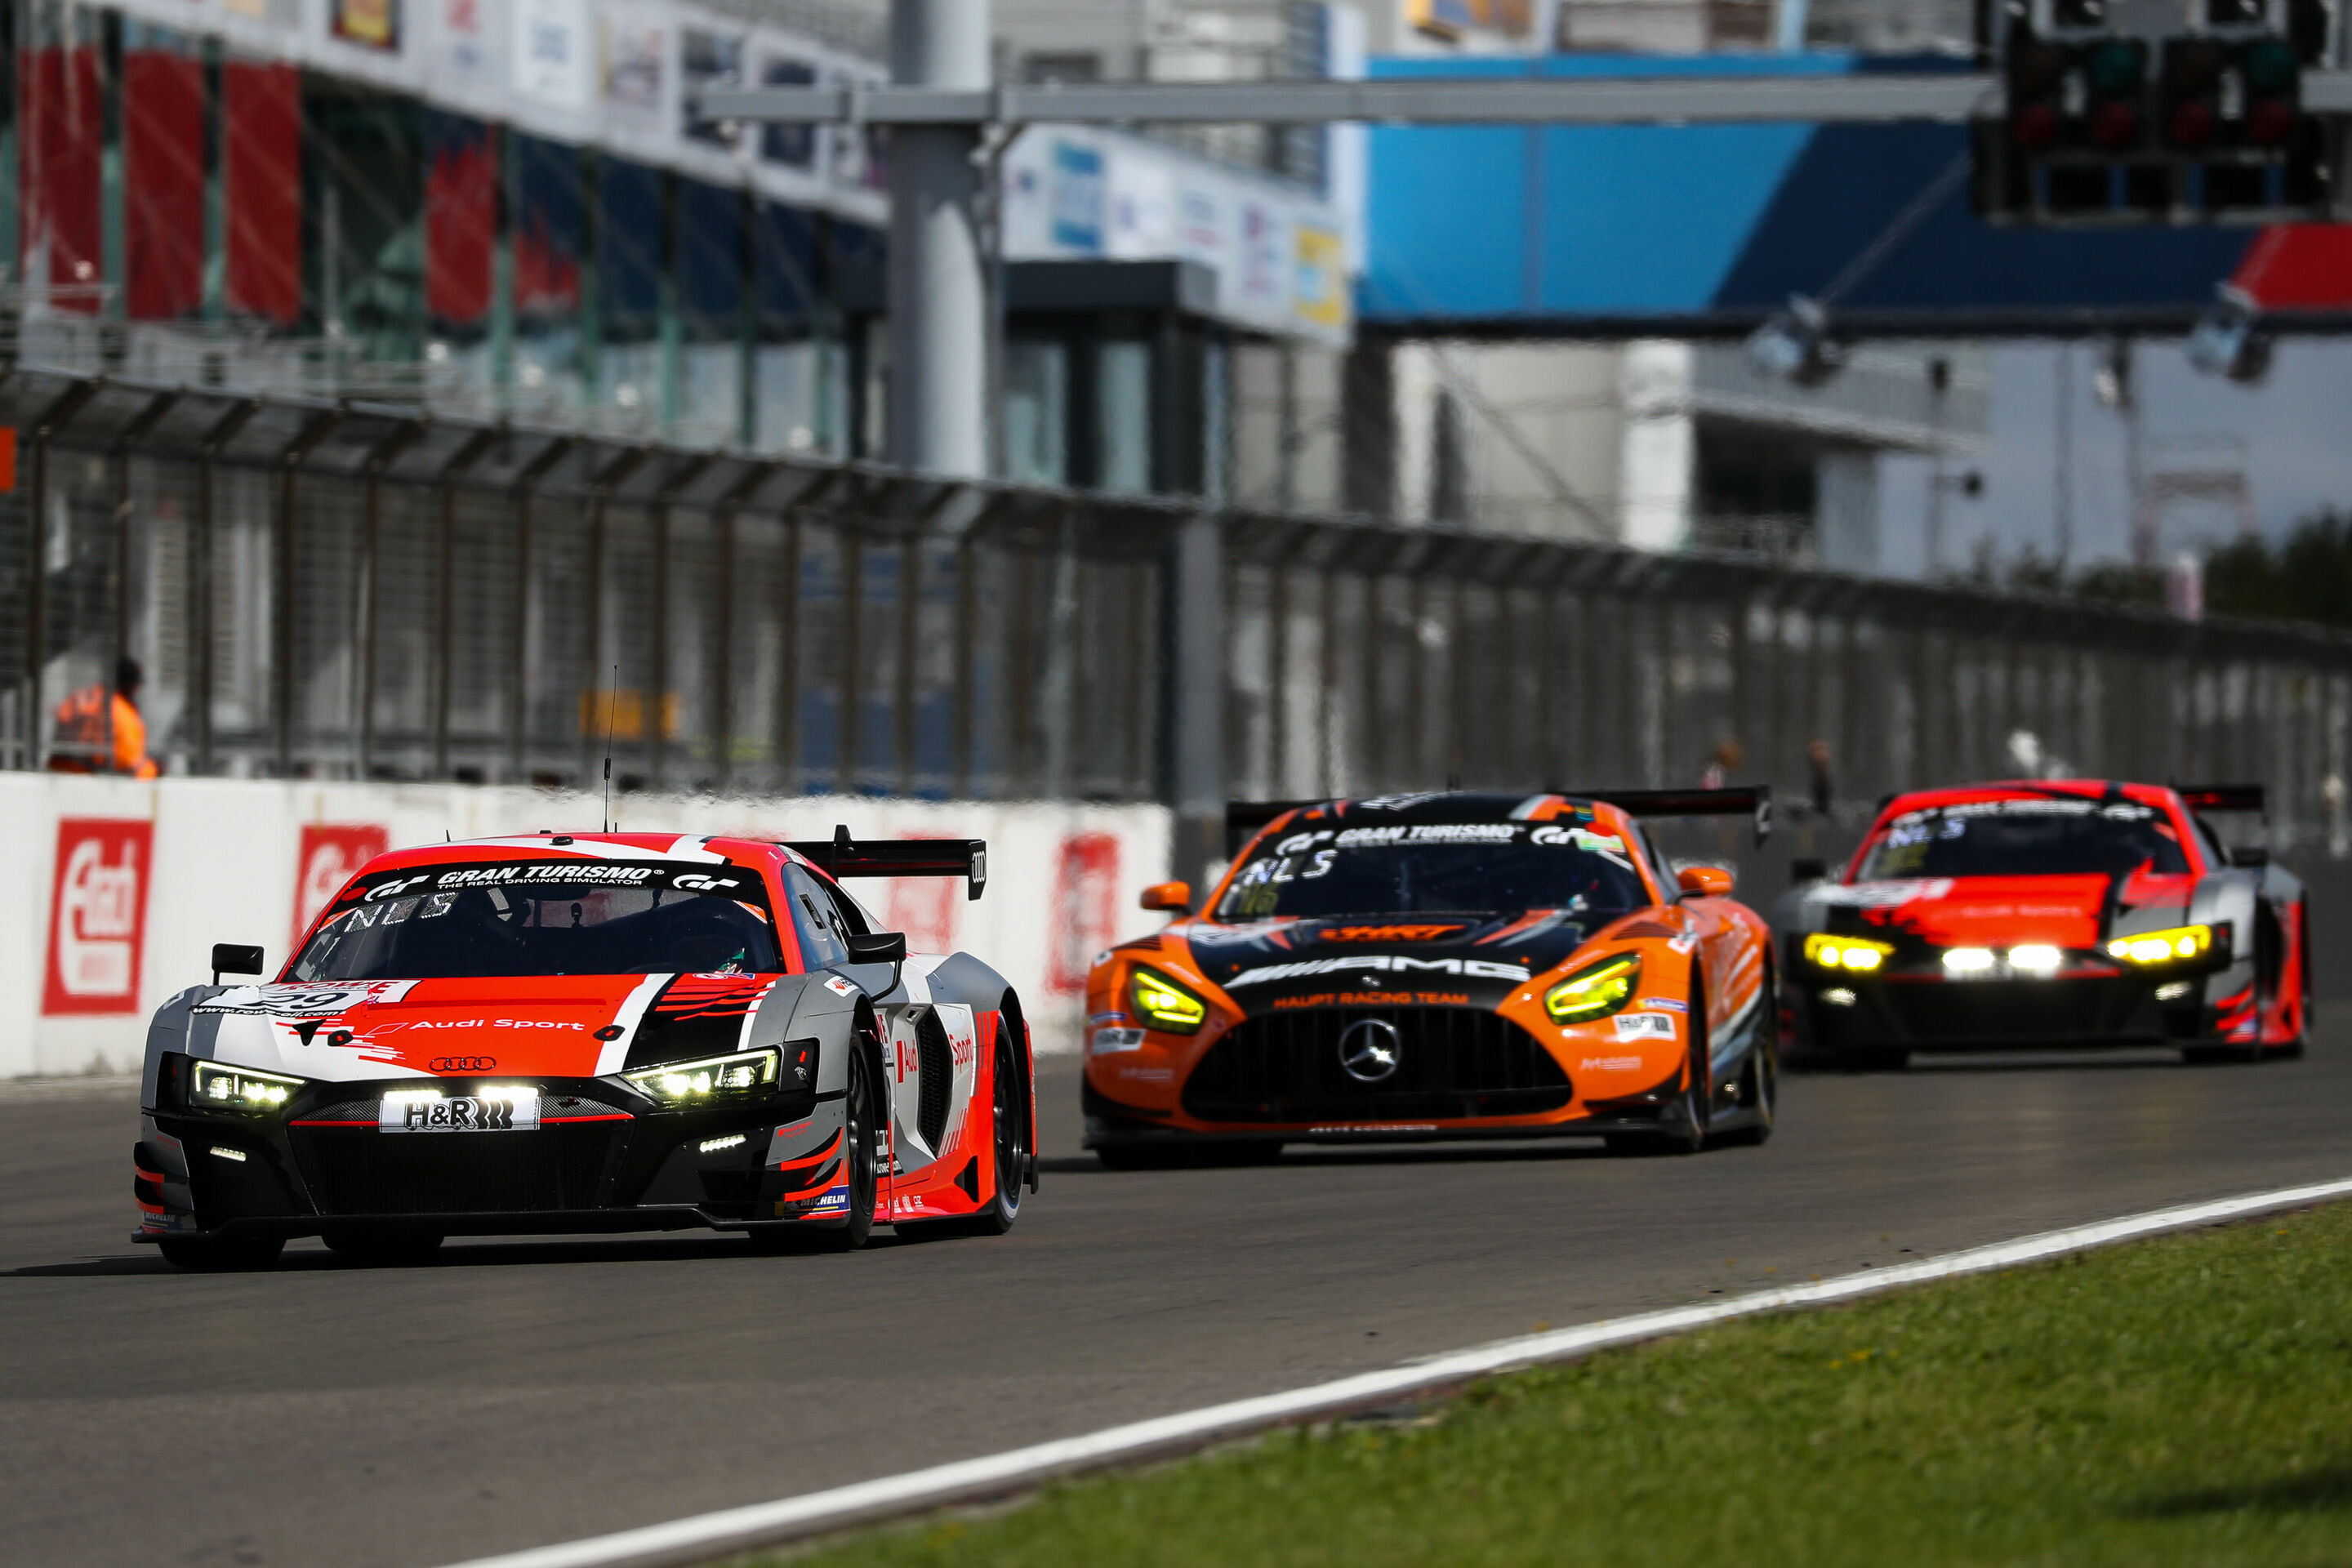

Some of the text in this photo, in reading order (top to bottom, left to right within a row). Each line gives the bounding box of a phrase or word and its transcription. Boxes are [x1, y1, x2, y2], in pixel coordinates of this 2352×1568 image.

[1335, 825, 1407, 844] GRAN
[438, 866, 521, 884] GRAN
[1243, 849, 1339, 887] NLS
[505, 876, 560, 884] DRIVING
[564, 876, 643, 885] SIMULATOR
[344, 892, 459, 933] NLS
[1313, 956, 1531, 982] AMG
[280, 980, 400, 994] ROWE
[238, 991, 350, 1010] 29
[1273, 991, 1469, 1009] HAUPT RACING TEAM
[193, 1006, 339, 1018] www.rowe-oil.com
[408, 1018, 586, 1031] Audi Sport
[903, 1033, 973, 1073] Audi Sport
[405, 1098, 474, 1129] H&R
[800, 1194, 847, 1206] MICHELIN
